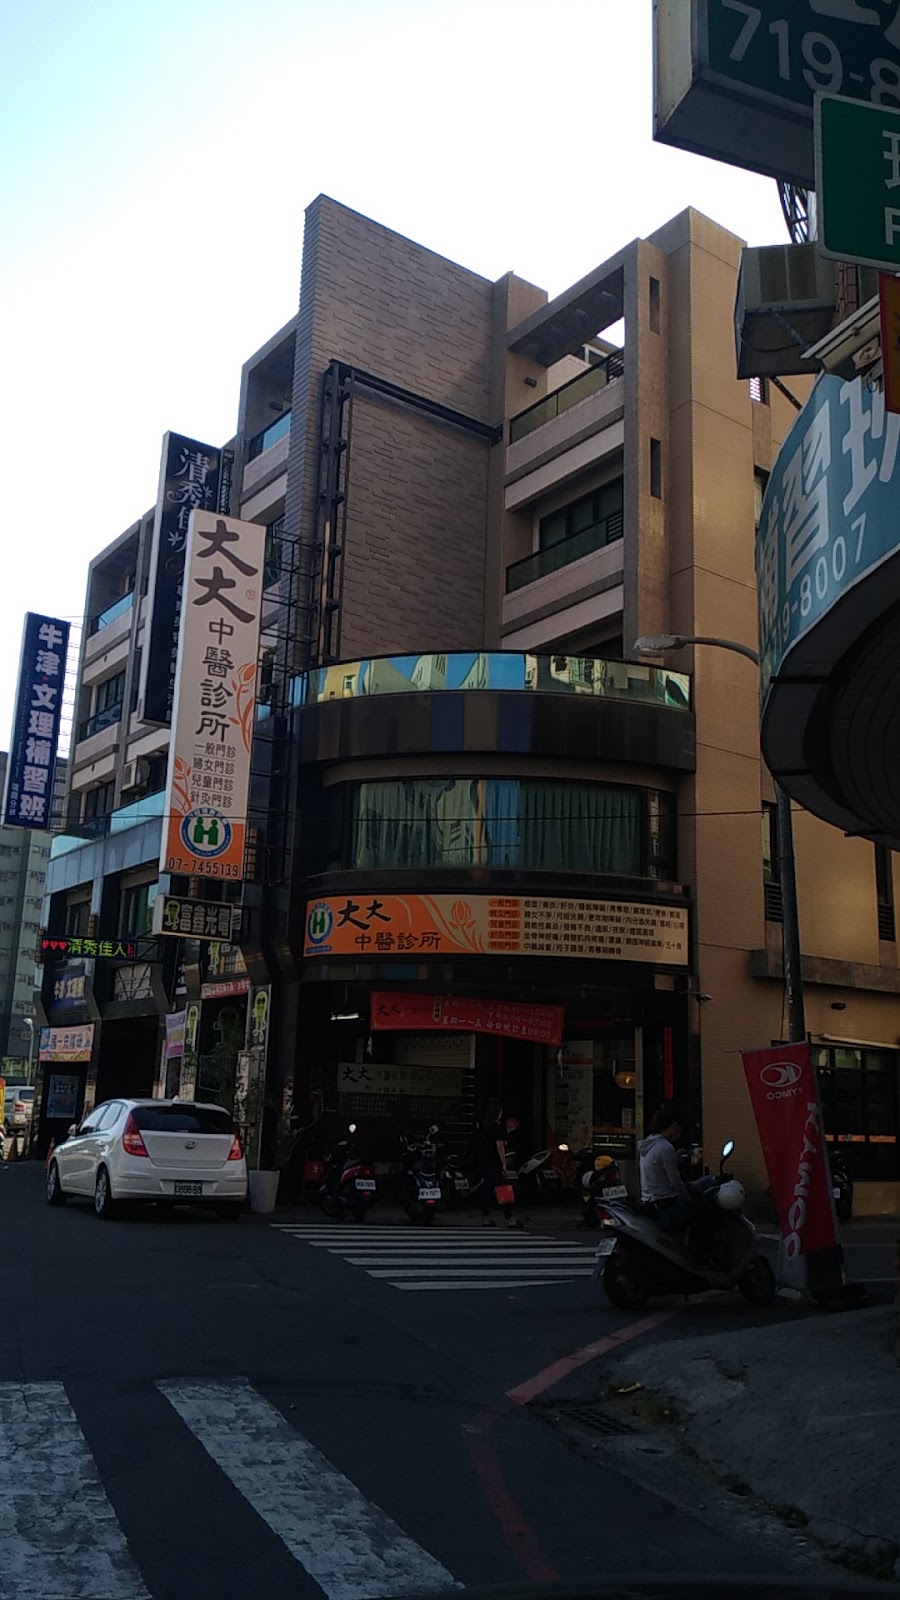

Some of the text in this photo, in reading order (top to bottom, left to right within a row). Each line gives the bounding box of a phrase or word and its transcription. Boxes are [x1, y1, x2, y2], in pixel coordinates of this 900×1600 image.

[194, 617, 236, 744] 中醫診所
[194, 742, 237, 759] 一般門診
[192, 757, 236, 776] 婦女門診
[191, 773, 234, 792] 兒童門診
[190, 790, 233, 808] 針灸門診
[168, 857, 239, 877] 07-7455139
[179, 903, 231, 937] 富鑫光電
[337, 899, 391, 930] 大大
[67, 937, 127, 959] 清秀佳人
[354, 931, 441, 950] 中醫診所
